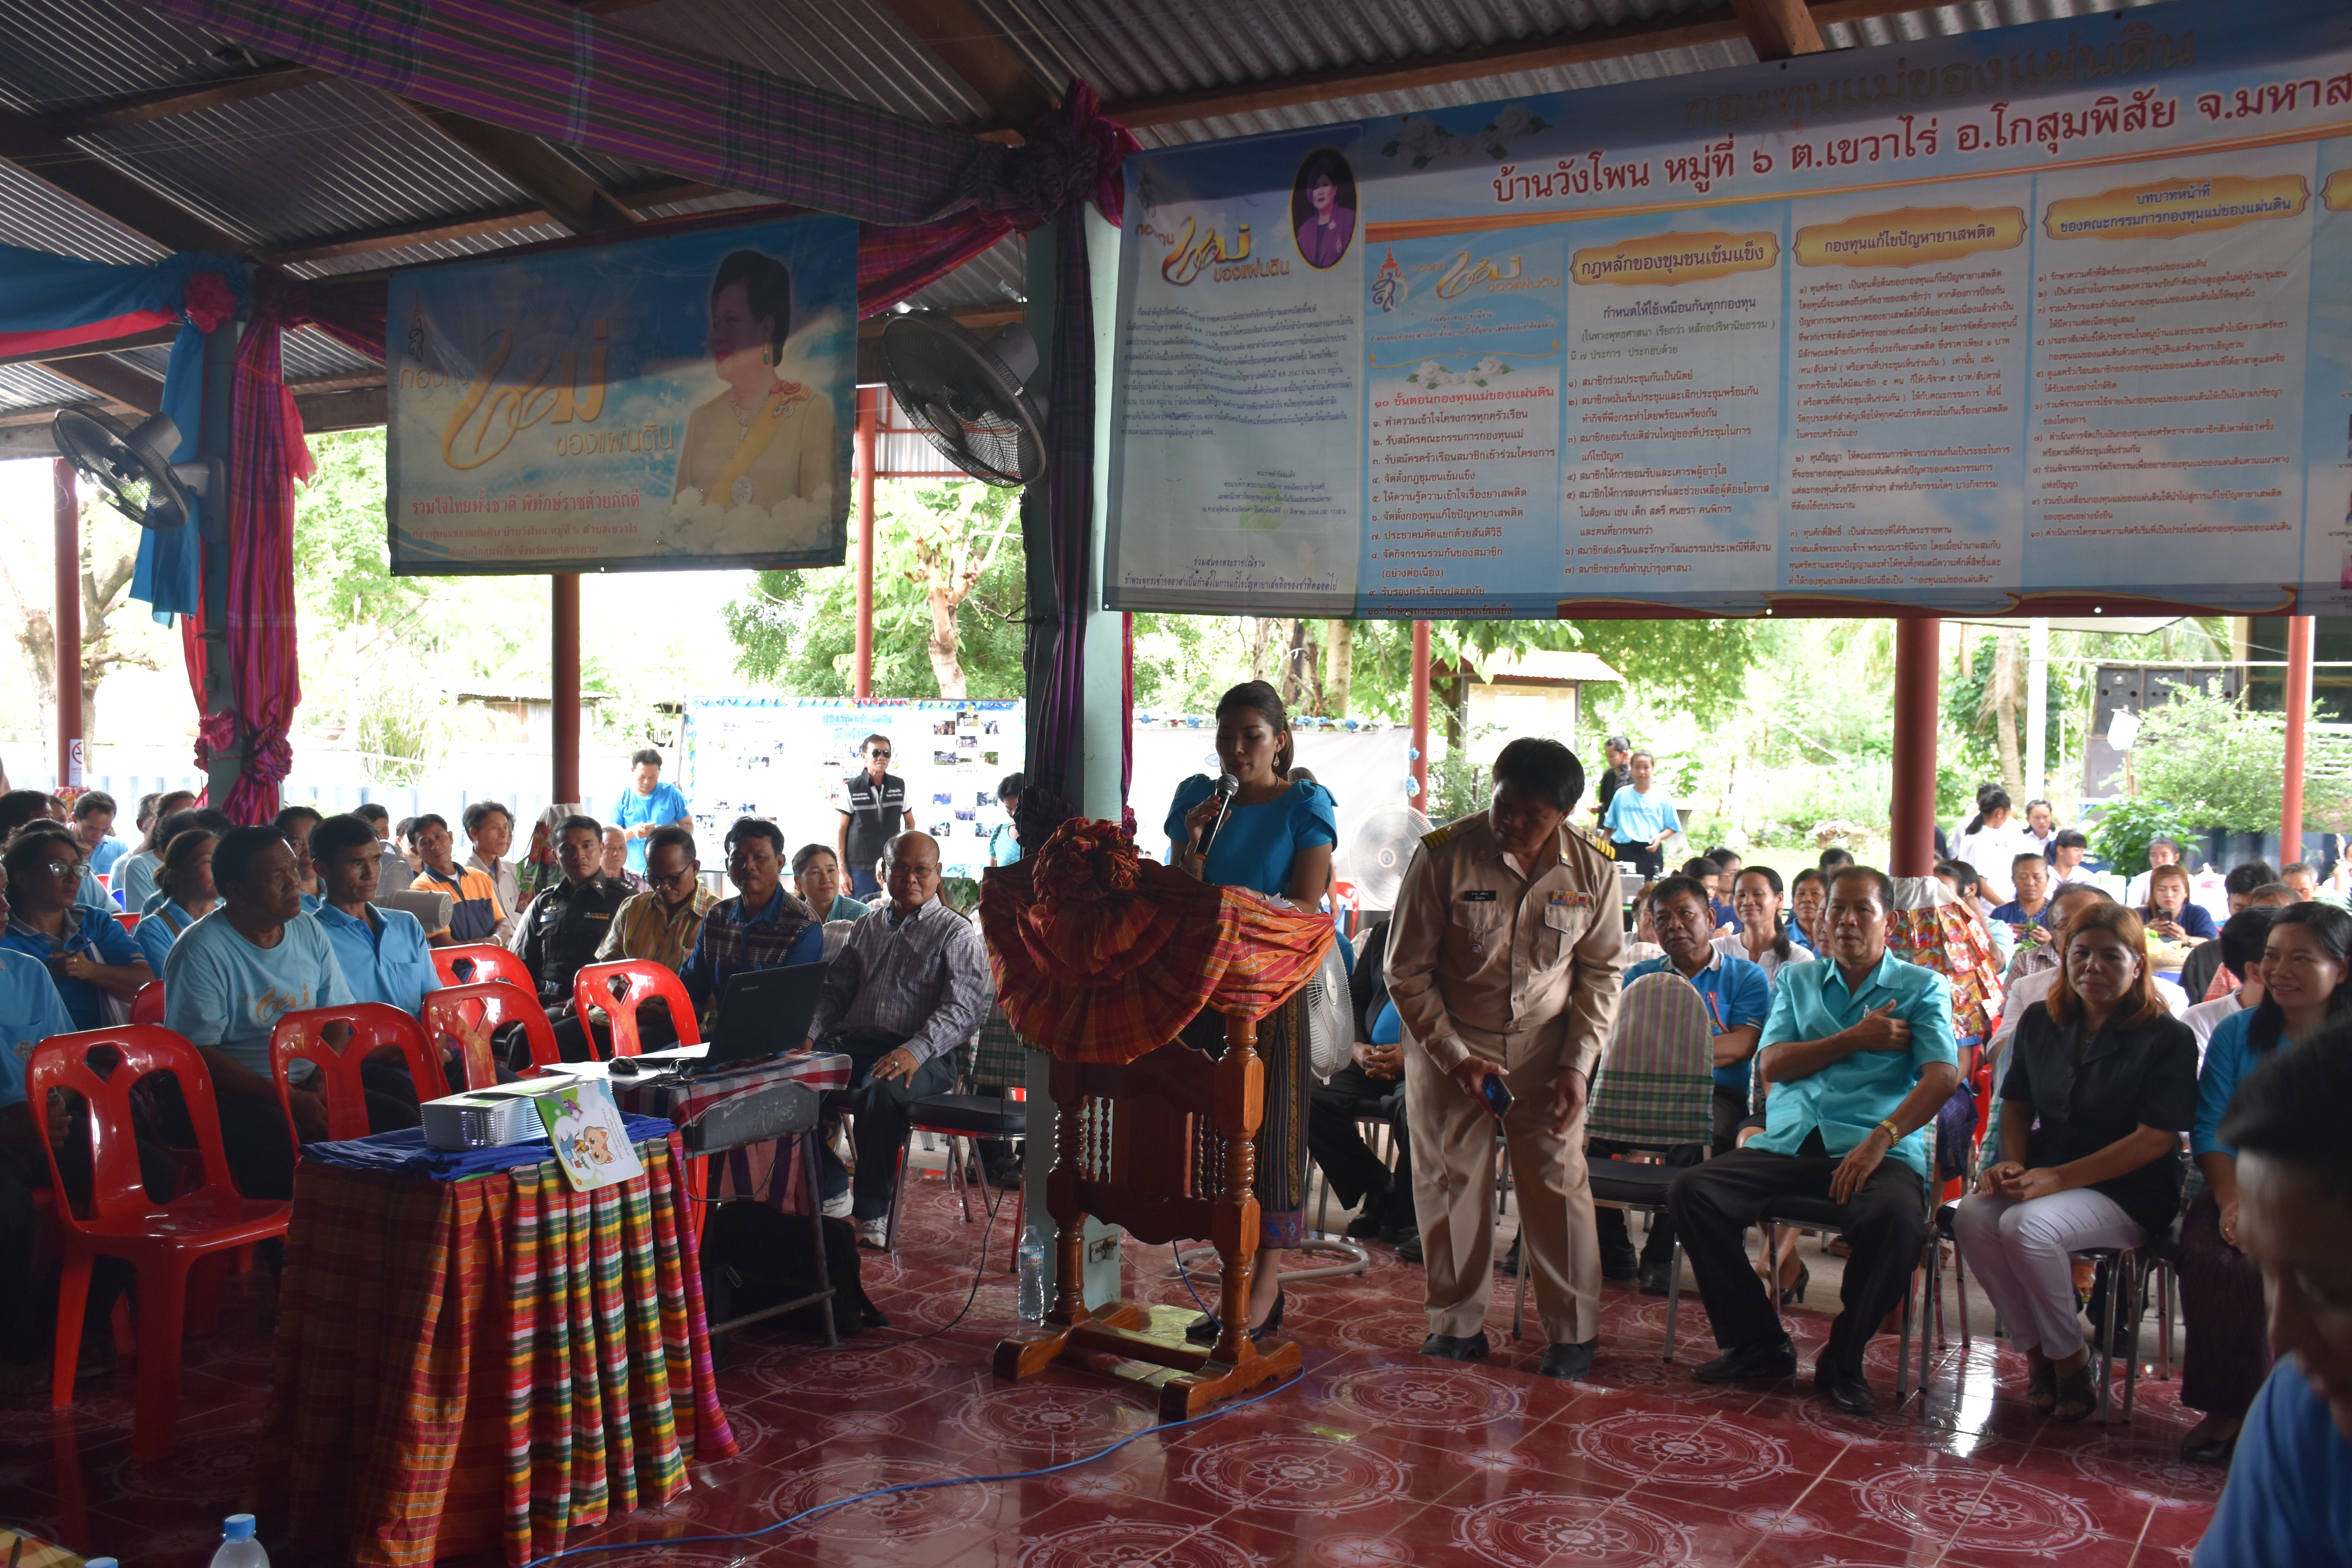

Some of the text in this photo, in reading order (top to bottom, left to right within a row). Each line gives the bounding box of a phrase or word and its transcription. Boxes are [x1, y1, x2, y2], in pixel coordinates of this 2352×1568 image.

[1492, 151, 1650, 205] บ้านวังโพน
[1664, 133, 1735, 193] หมู่ที่
[1752, 149, 1773, 174] ๖
[1791, 116, 1939, 172] ต.เขวาไร่
[1956, 86, 2176, 156] อ.โกสุมพิสัย
[2136, 180, 2211, 205] บทบาทหน้าที่
[1824, 223, 1995, 256] กองทุนแก้ไขปัญหายาเสพติด
[1656, 325, 1684, 336] เรียกว่า
[1995, 337, 2010, 346] บาท
[1590, 348, 1621, 360] ประการ
[1628, 343, 1678, 358] ประกอบด้วย
[1582, 450, 1624, 463] แก้ไขปัญหา
[1956, 479, 1998, 490] บางกิจกรรม
[412, 488, 640, 515] รวมใจไทยทั้งชาติ พิทักษ์ราชด้วยภักดี
[1580, 506, 1611, 518] ในสังคม
[1614, 507, 1628, 517] เช่น
[1632, 505, 1646, 517] เด็ก
[504, 526, 547, 537] บ้านวังโพน
[551, 522, 570, 540] หมู่ที่
[1382, 564, 1444, 579] (อย่างต่อเนื่อง)
[1381, 585, 1485, 596] รับรองครัวเรือนปลอดภัย
